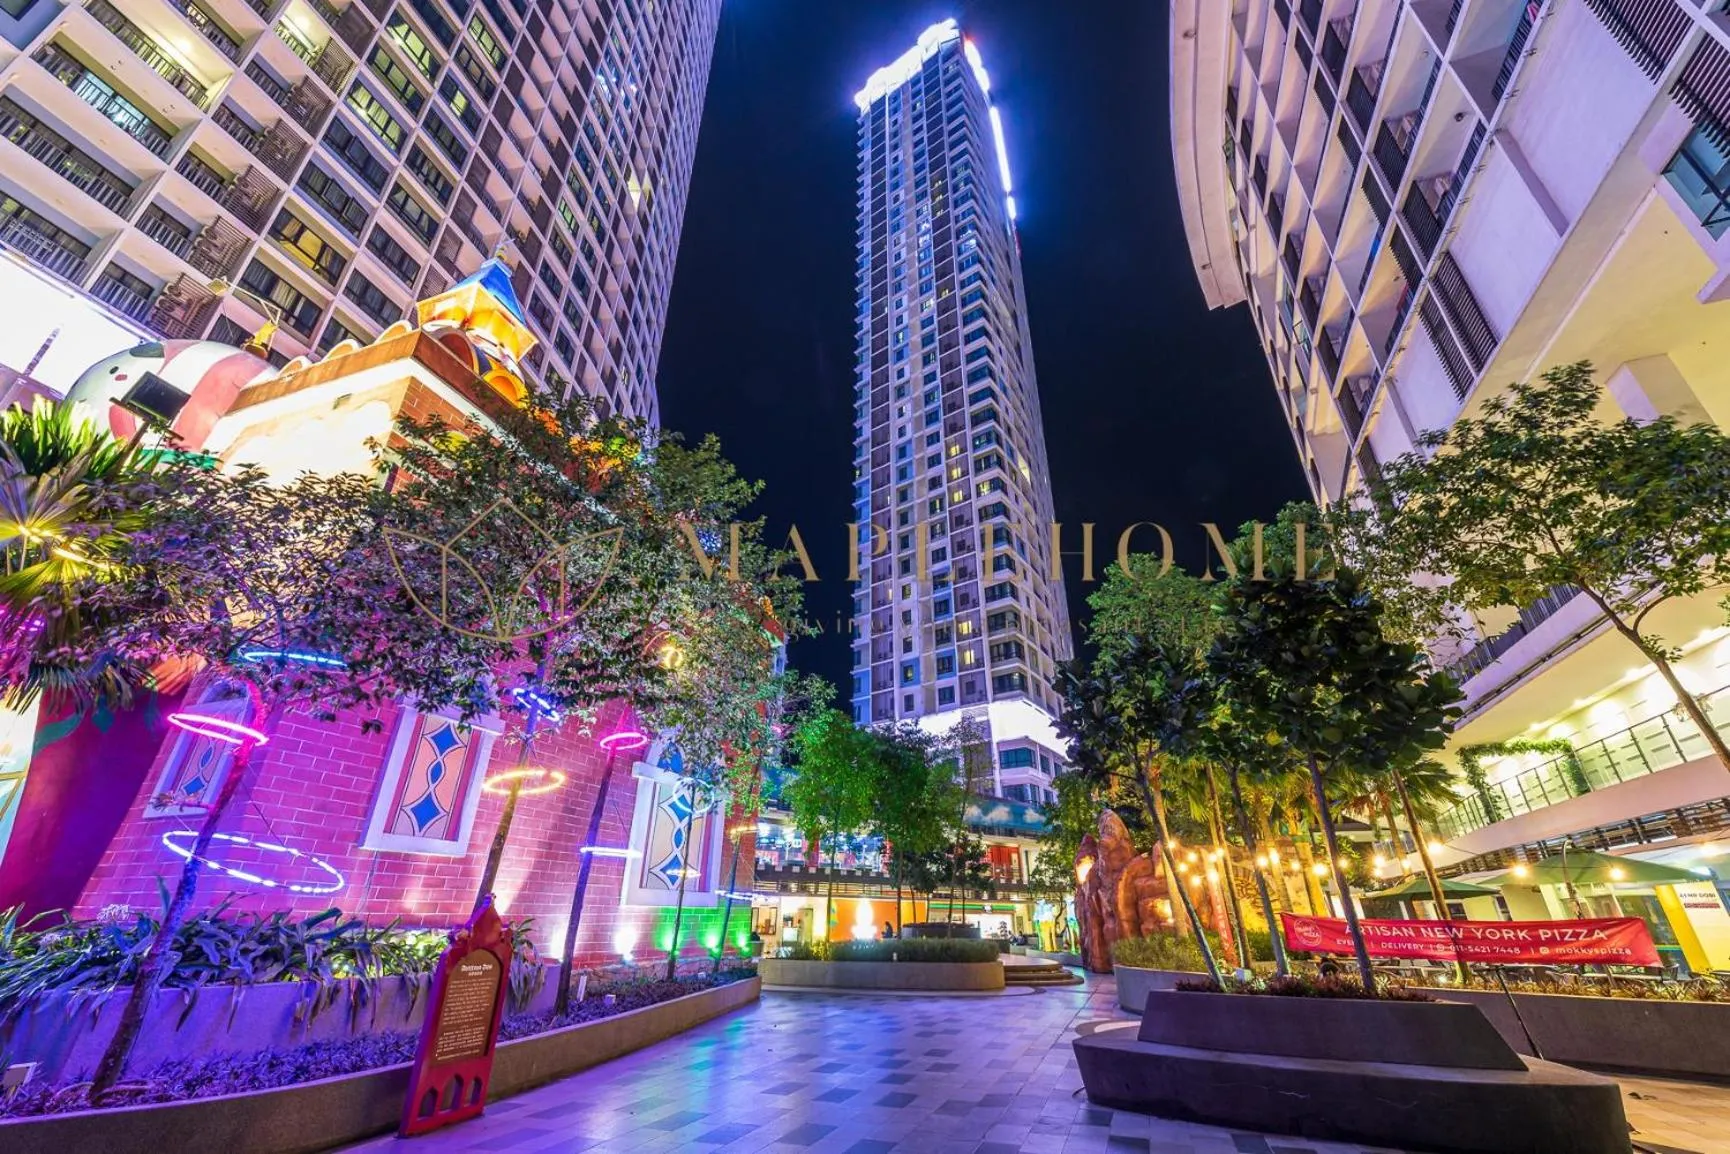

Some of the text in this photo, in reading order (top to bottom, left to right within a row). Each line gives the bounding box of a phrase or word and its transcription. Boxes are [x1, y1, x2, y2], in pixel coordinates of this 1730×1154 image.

[1420, 927, 1464, 938] NEW
[1471, 928, 1532, 940] YORK
[1538, 929, 1608, 941] PIZZA
[1381, 942, 1424, 951] DELIVERY
